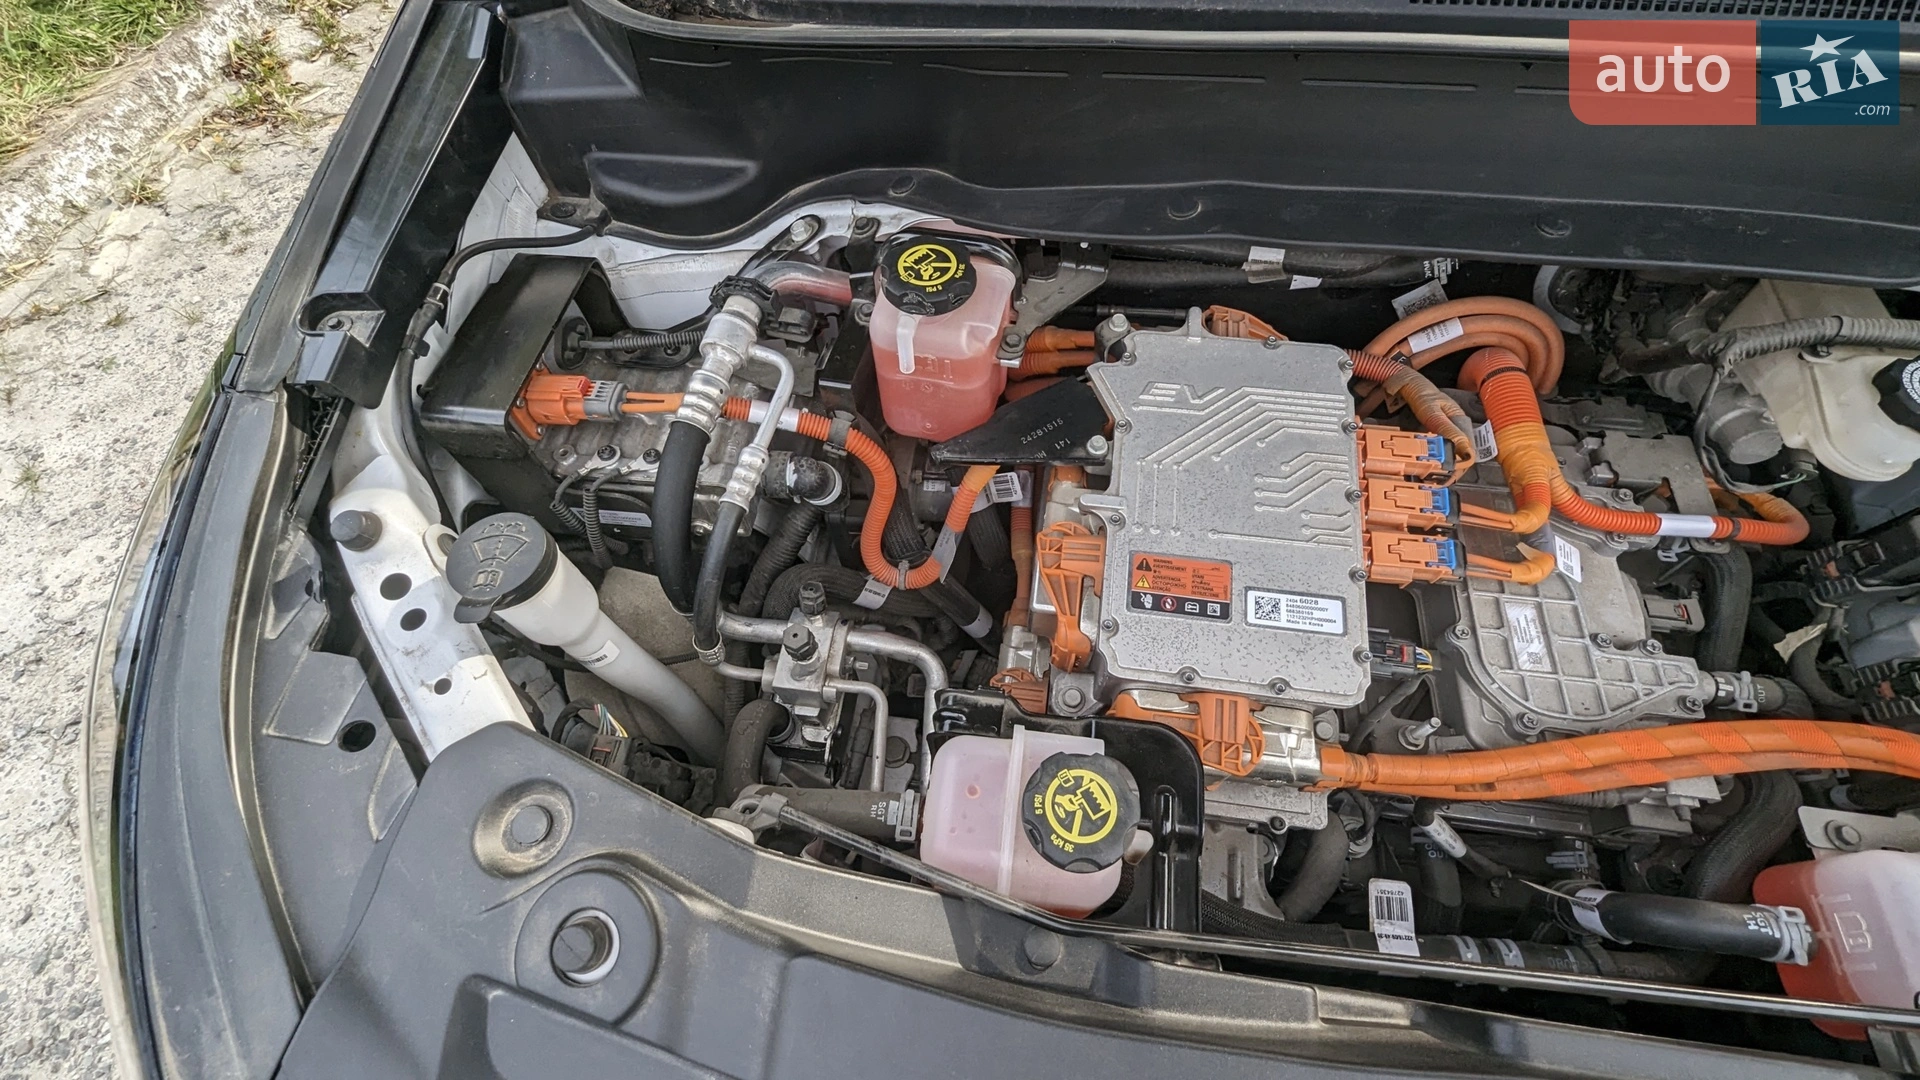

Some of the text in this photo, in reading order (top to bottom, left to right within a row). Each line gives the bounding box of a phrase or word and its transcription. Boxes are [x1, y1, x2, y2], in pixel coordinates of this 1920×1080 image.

[1020, 418, 1064, 445] 24281515
[1756, 683, 1766, 703] OUT
[1034, 794, 1043, 807] PSI
[870, 804, 877, 818] RH
[876, 801, 886, 822] SGT
[1050, 833, 1074, 853] 35 kPa
[1751, 912, 1772, 935] SGT
